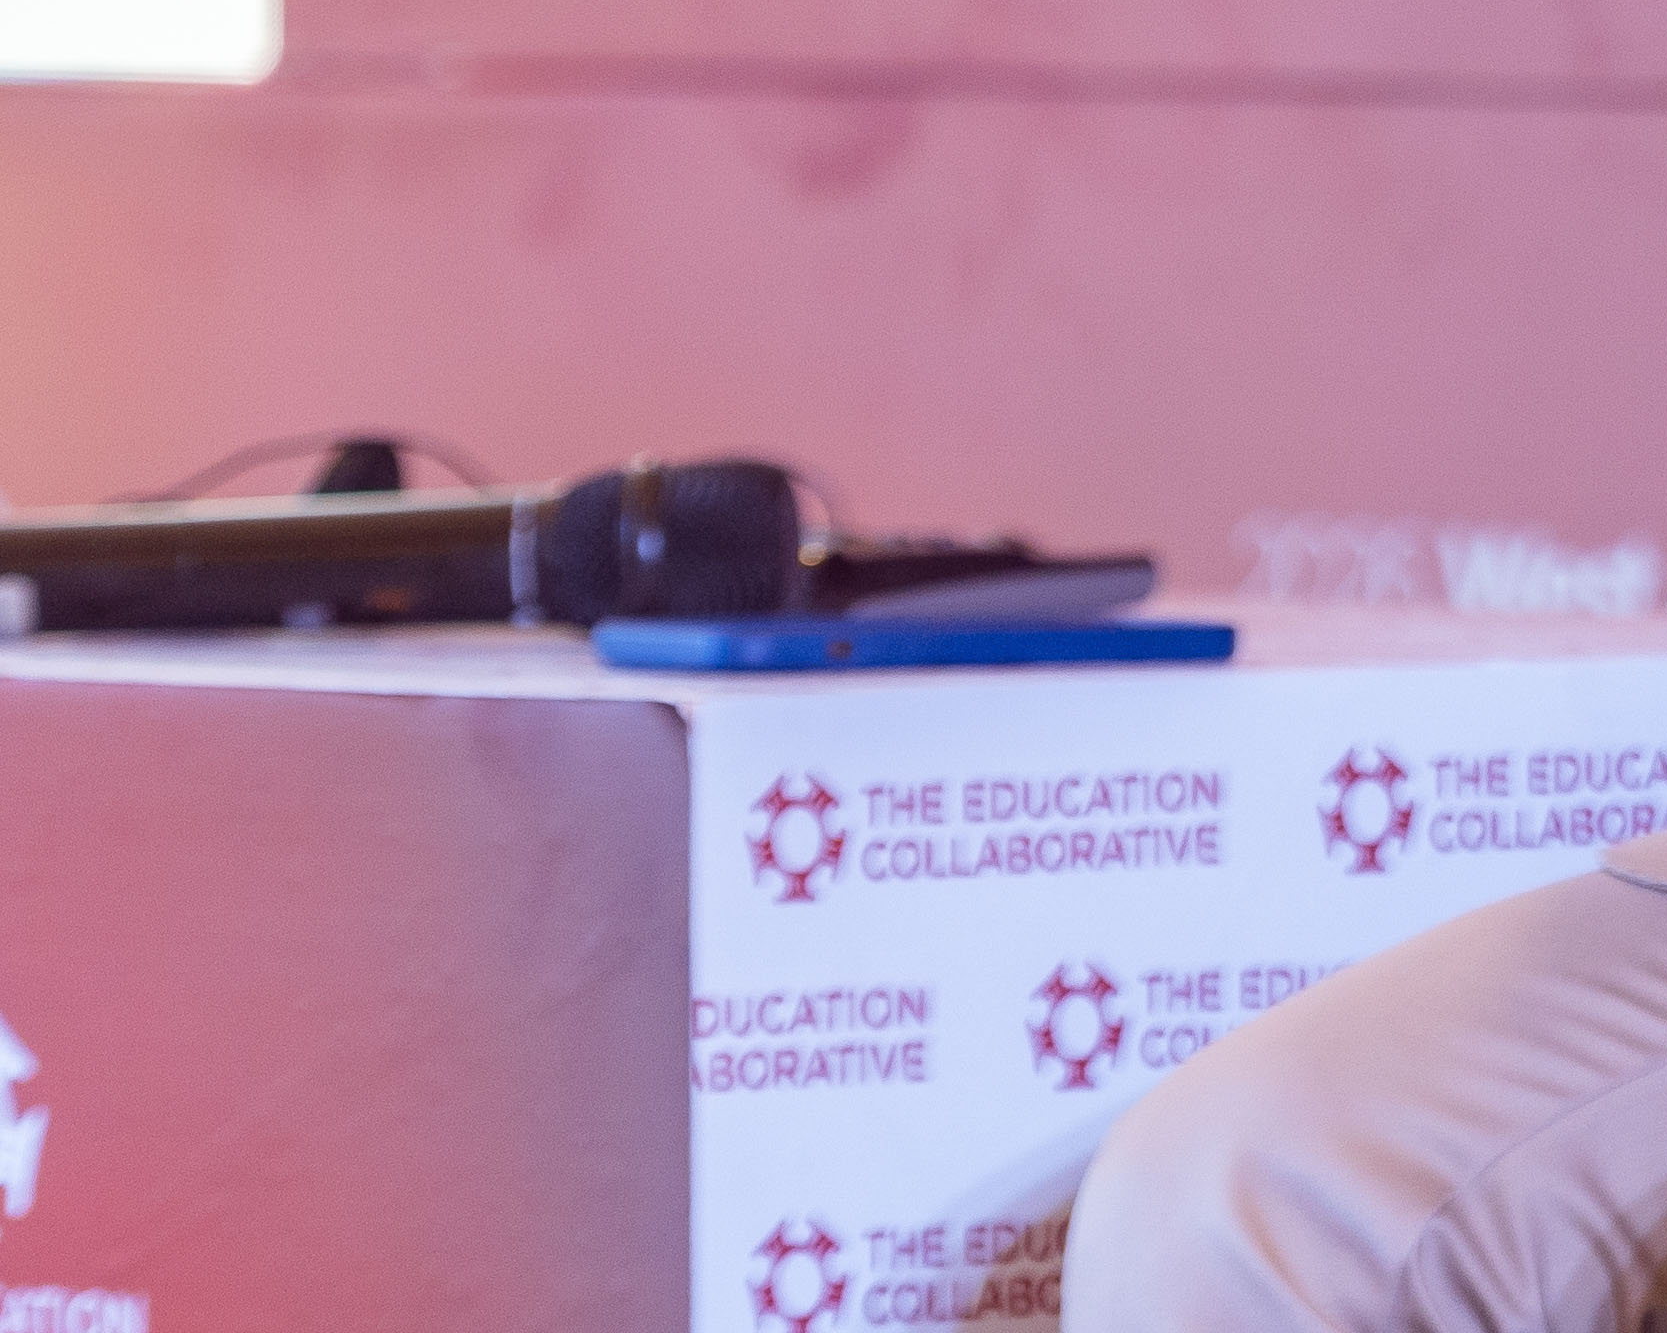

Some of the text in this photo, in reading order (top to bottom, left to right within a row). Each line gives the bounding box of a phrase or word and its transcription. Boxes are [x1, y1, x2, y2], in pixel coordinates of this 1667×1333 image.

[862, 770, 1222, 826] THE EDUCATION
[1430, 757, 1509, 796] THE
[861, 824, 1222, 881] COLLABORATIVE
[1140, 970, 1222, 1014] THE
[863, 1226, 946, 1270] THE
